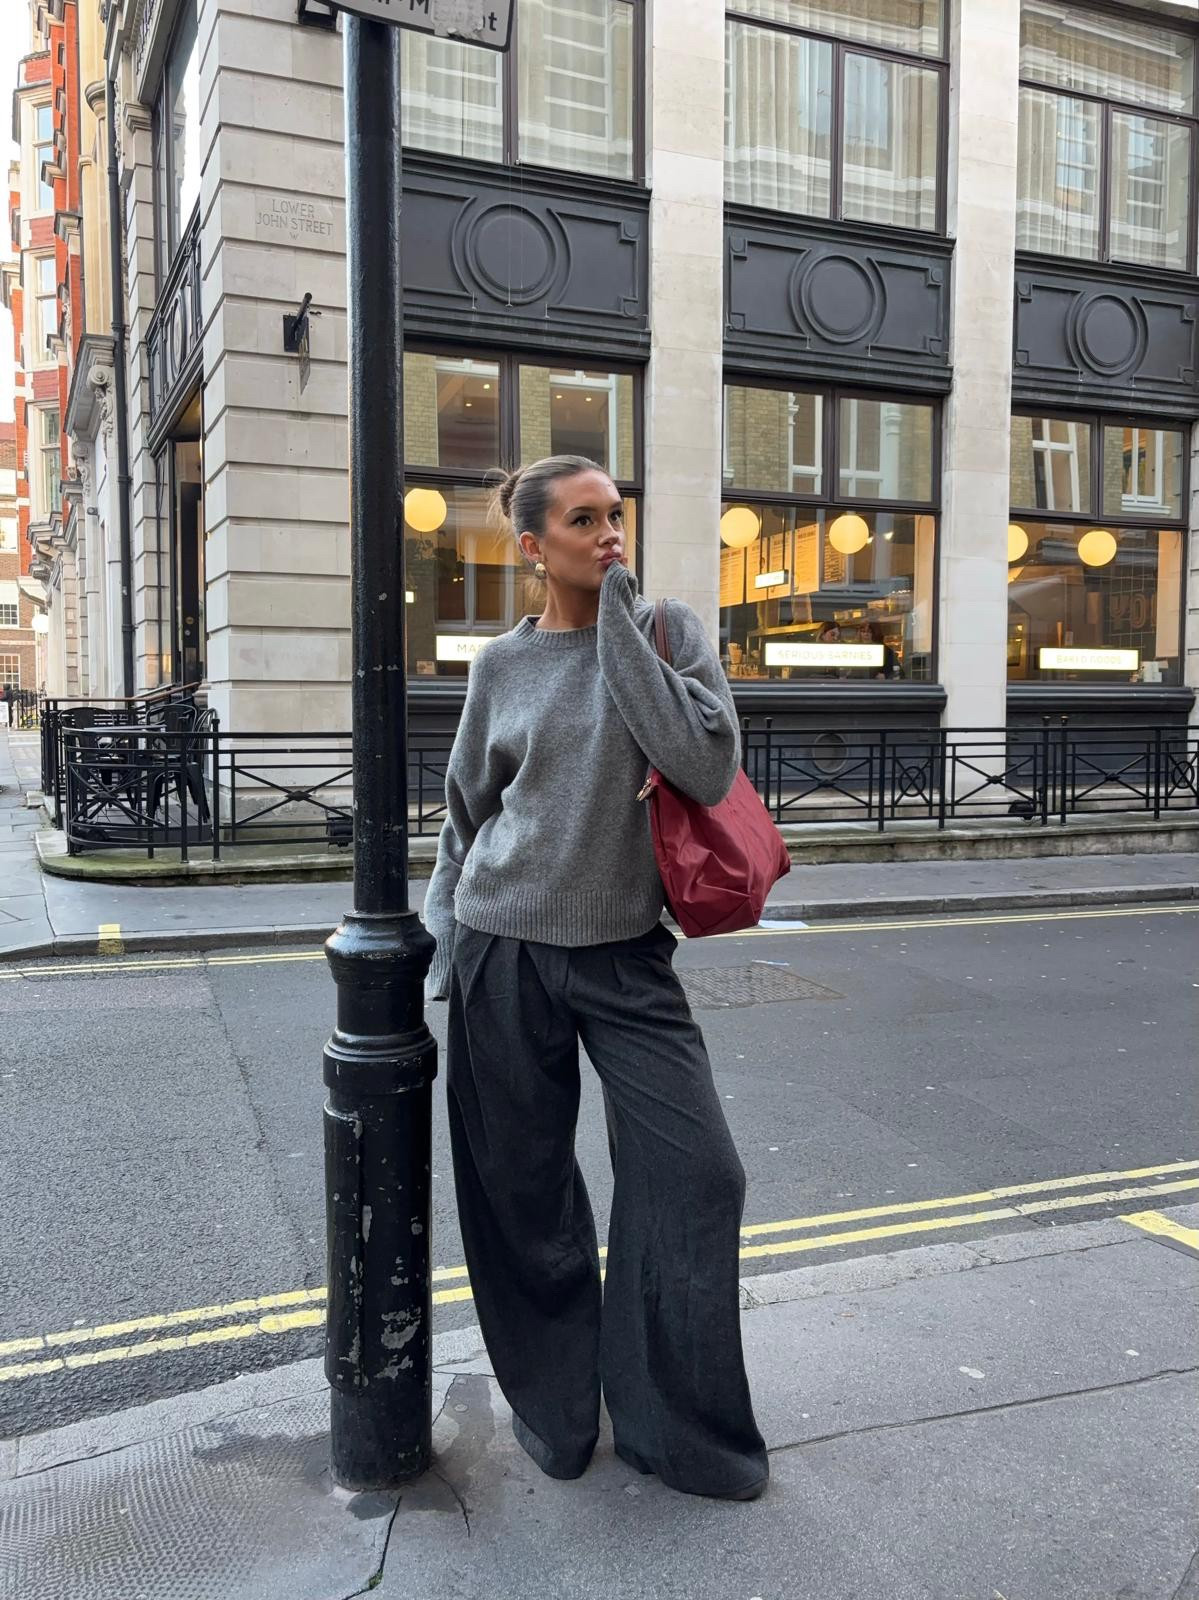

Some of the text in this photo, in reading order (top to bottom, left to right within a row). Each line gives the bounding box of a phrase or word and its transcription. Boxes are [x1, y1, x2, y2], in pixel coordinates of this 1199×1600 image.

[271, 199, 314, 218] LOWER
[255, 212, 333, 236] JOHN STREET
